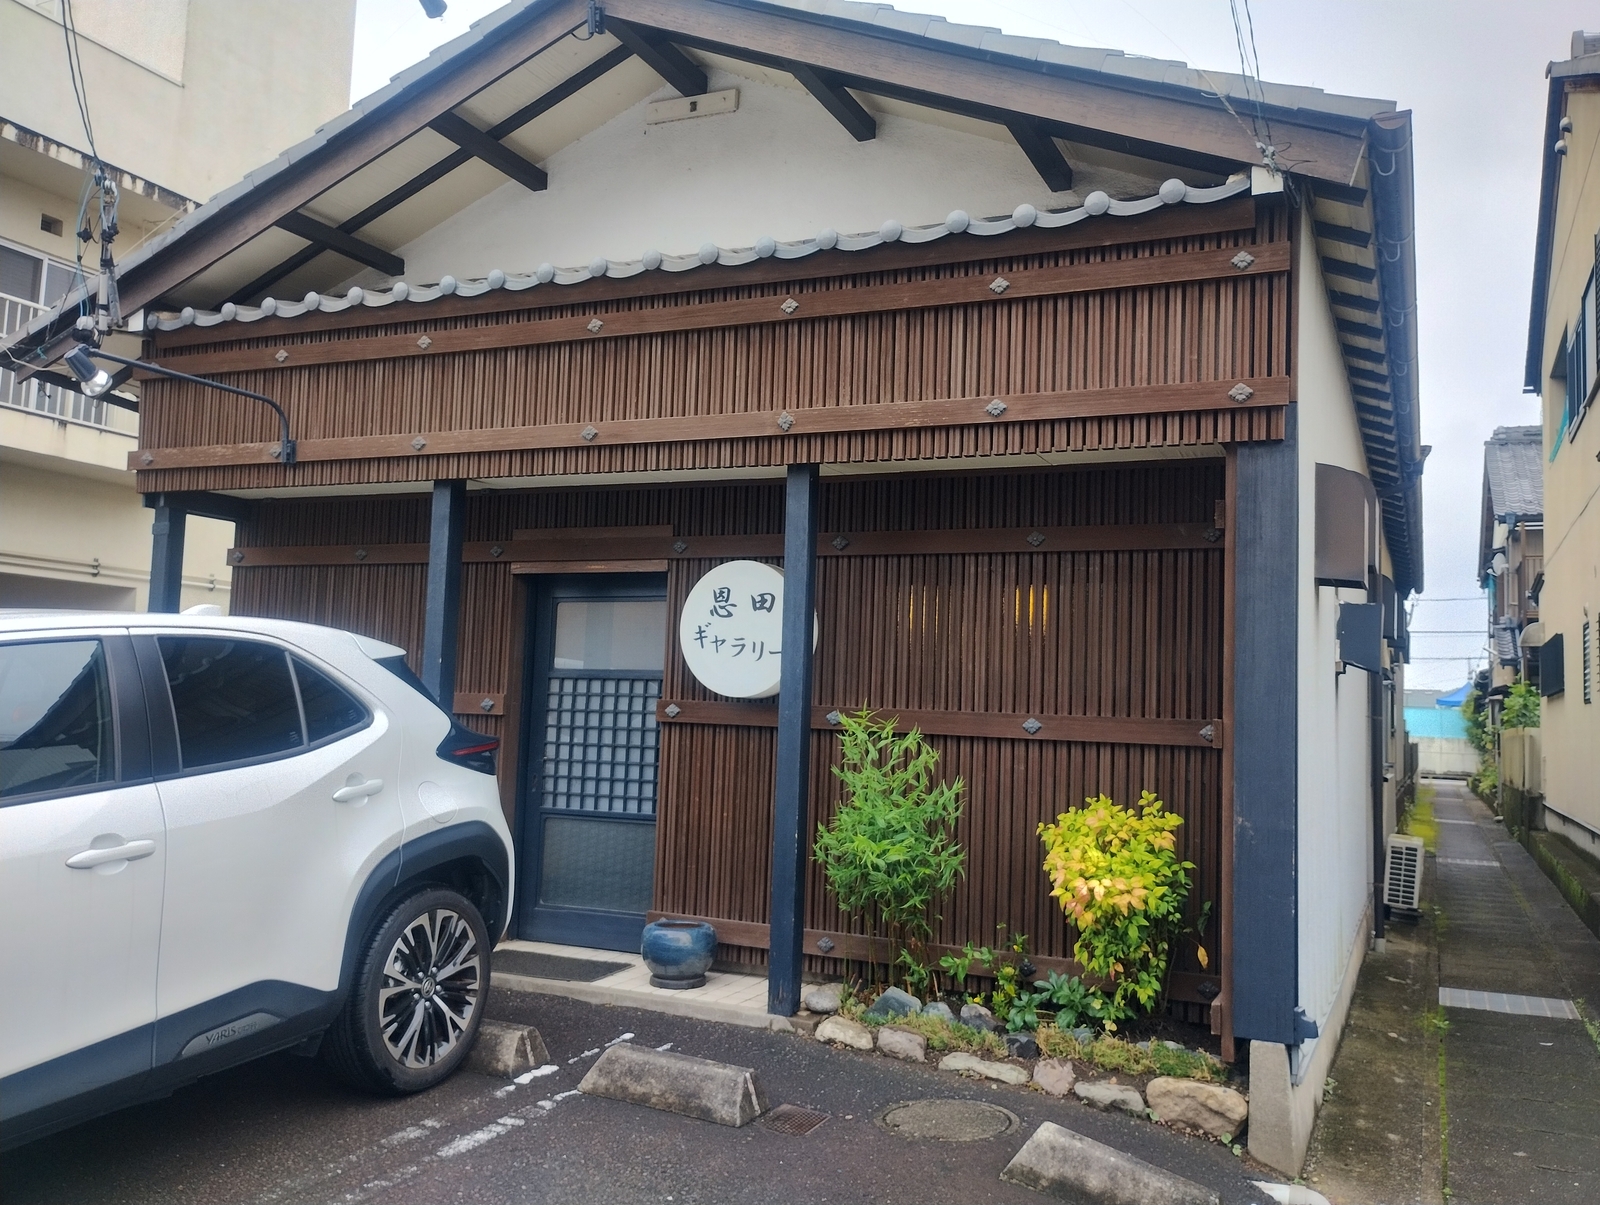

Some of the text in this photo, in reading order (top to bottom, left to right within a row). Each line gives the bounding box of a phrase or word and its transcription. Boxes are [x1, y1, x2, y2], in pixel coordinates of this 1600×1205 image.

[710, 587, 776, 618] 恩田
[694, 622, 782, 662] ギャラリー
[205, 1025, 237, 1045] YARIS
